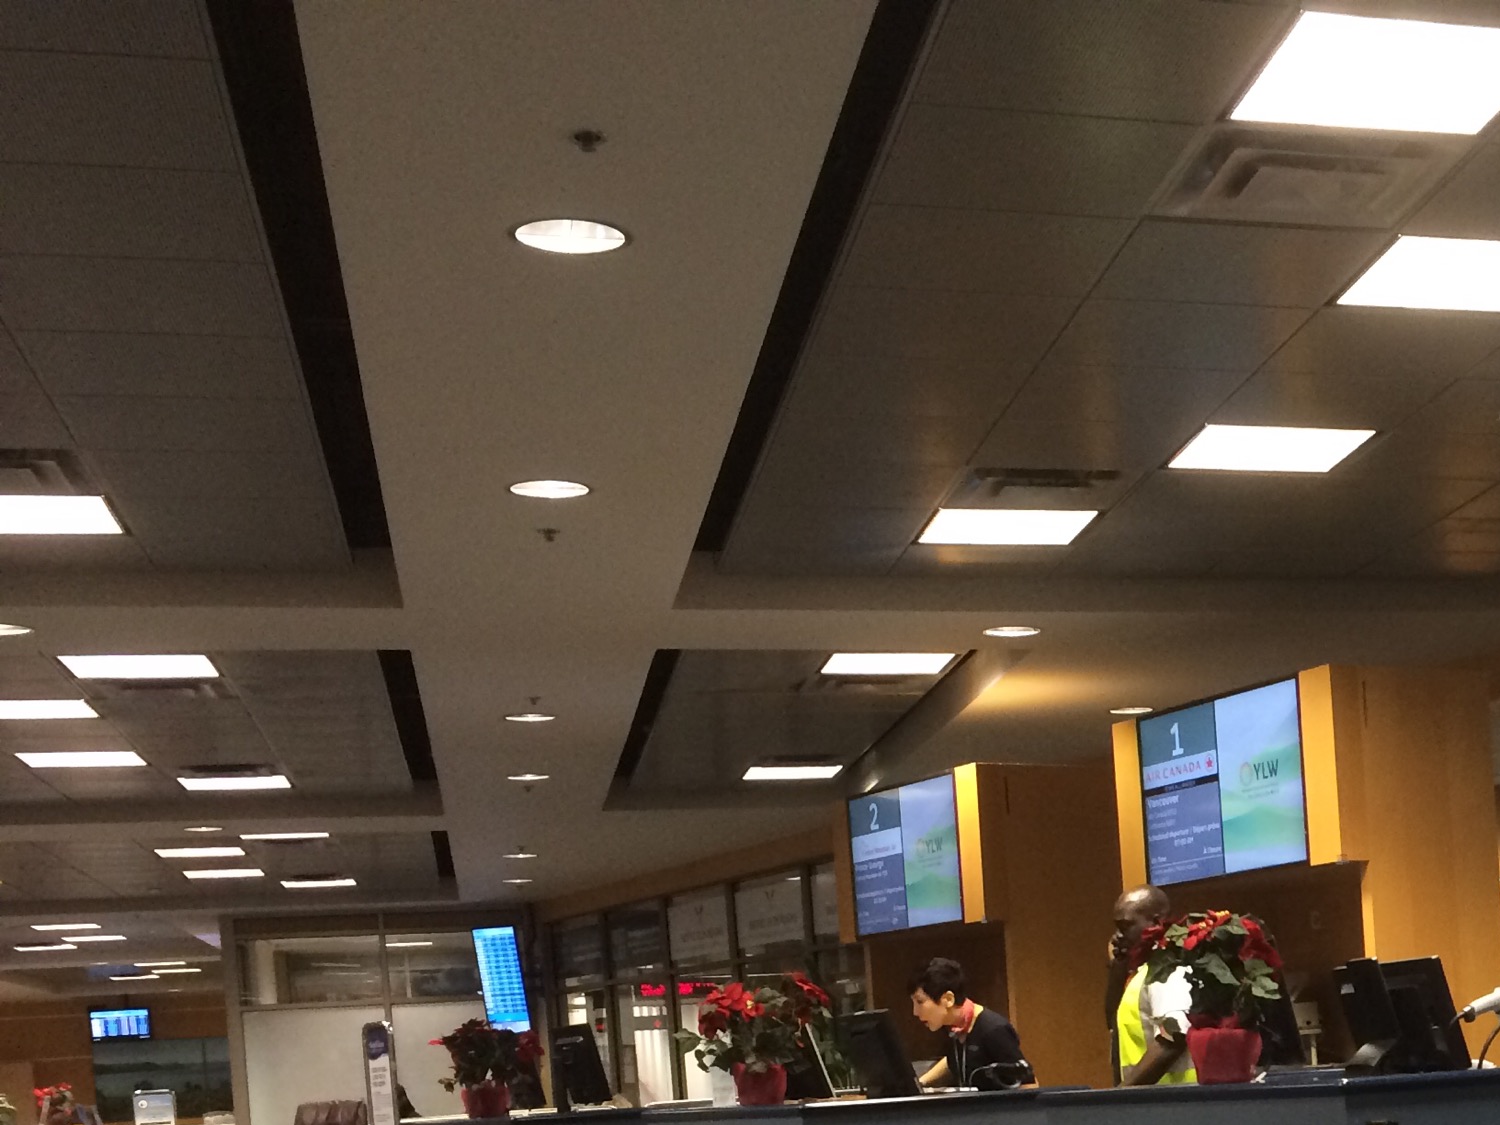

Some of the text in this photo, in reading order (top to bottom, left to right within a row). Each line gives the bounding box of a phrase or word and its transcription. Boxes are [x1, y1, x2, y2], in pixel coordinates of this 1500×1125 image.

[1170, 722, 1184, 756] 1
[1145, 760, 1201, 784] AIR CANADA
[1254, 758, 1278, 780] YLW
[869, 802, 880, 830] 2
[926, 837, 942, 854] YLW
